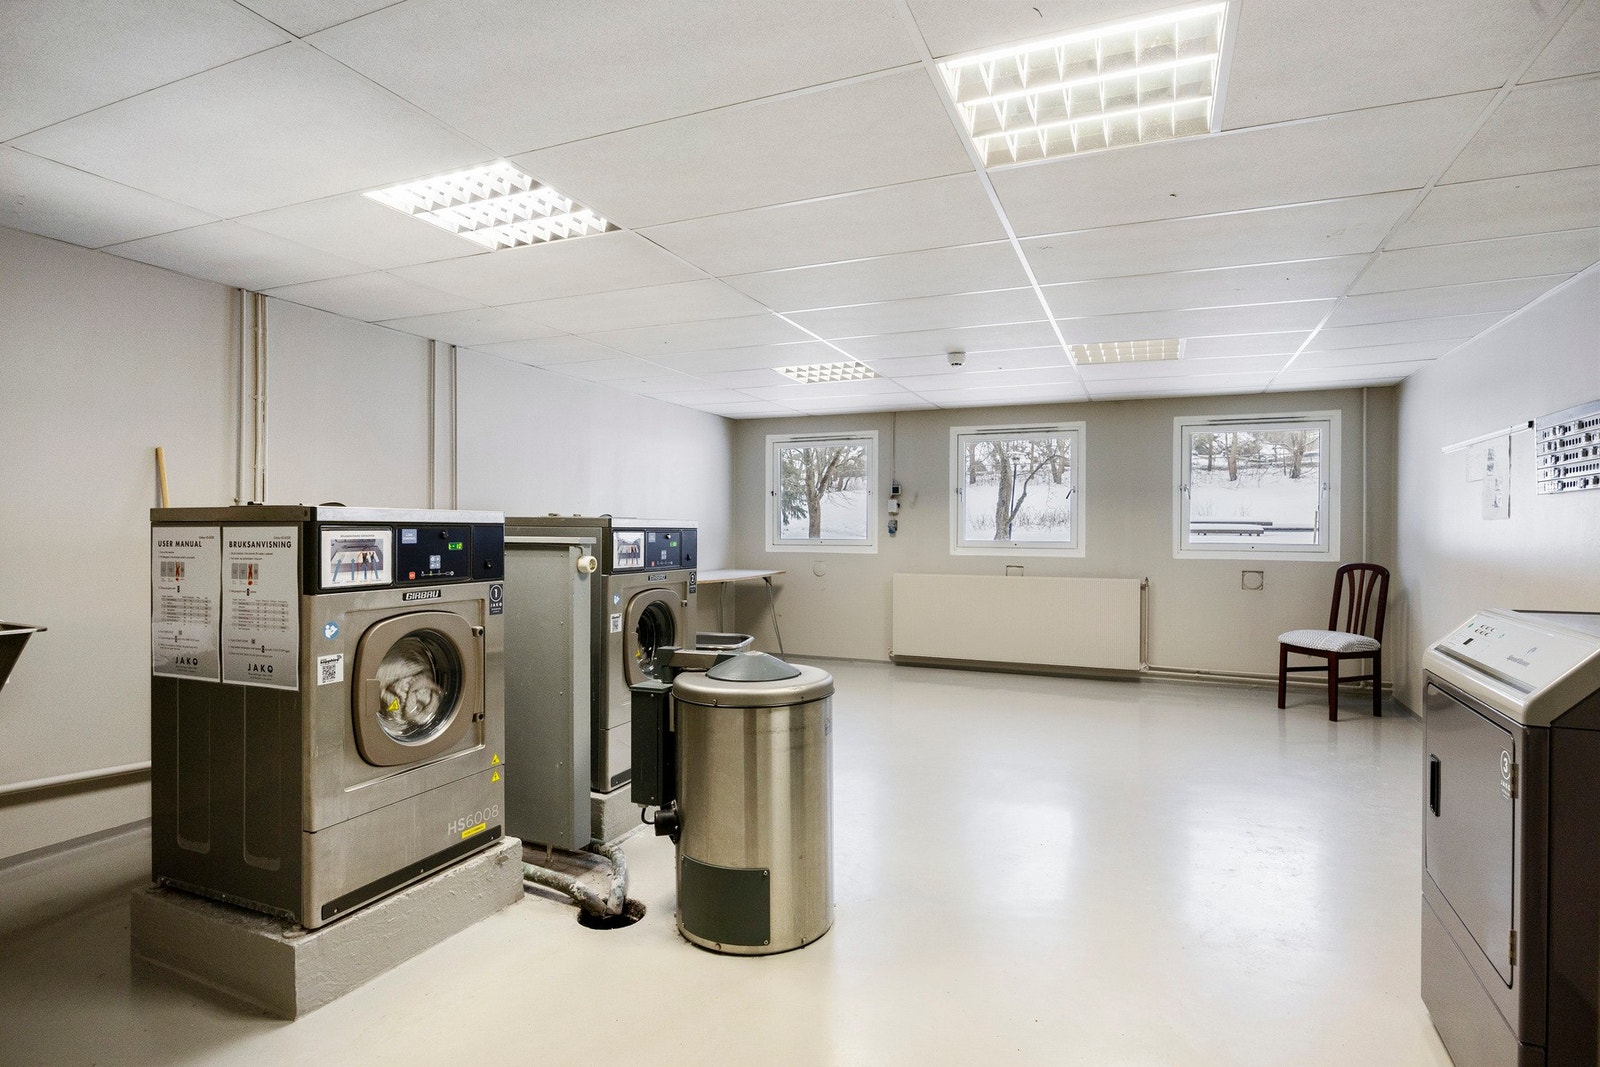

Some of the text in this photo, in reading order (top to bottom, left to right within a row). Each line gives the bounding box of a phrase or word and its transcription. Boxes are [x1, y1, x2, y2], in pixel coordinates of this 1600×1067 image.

[158, 540, 202, 548] USER MANUAL
[405, 590, 439, 600] GIRBAU
[175, 657, 198, 666] JAKO
[248, 663, 274, 673] JAKO
[1503, 757, 1508, 773] 3
[447, 804, 499, 836] HS6008
